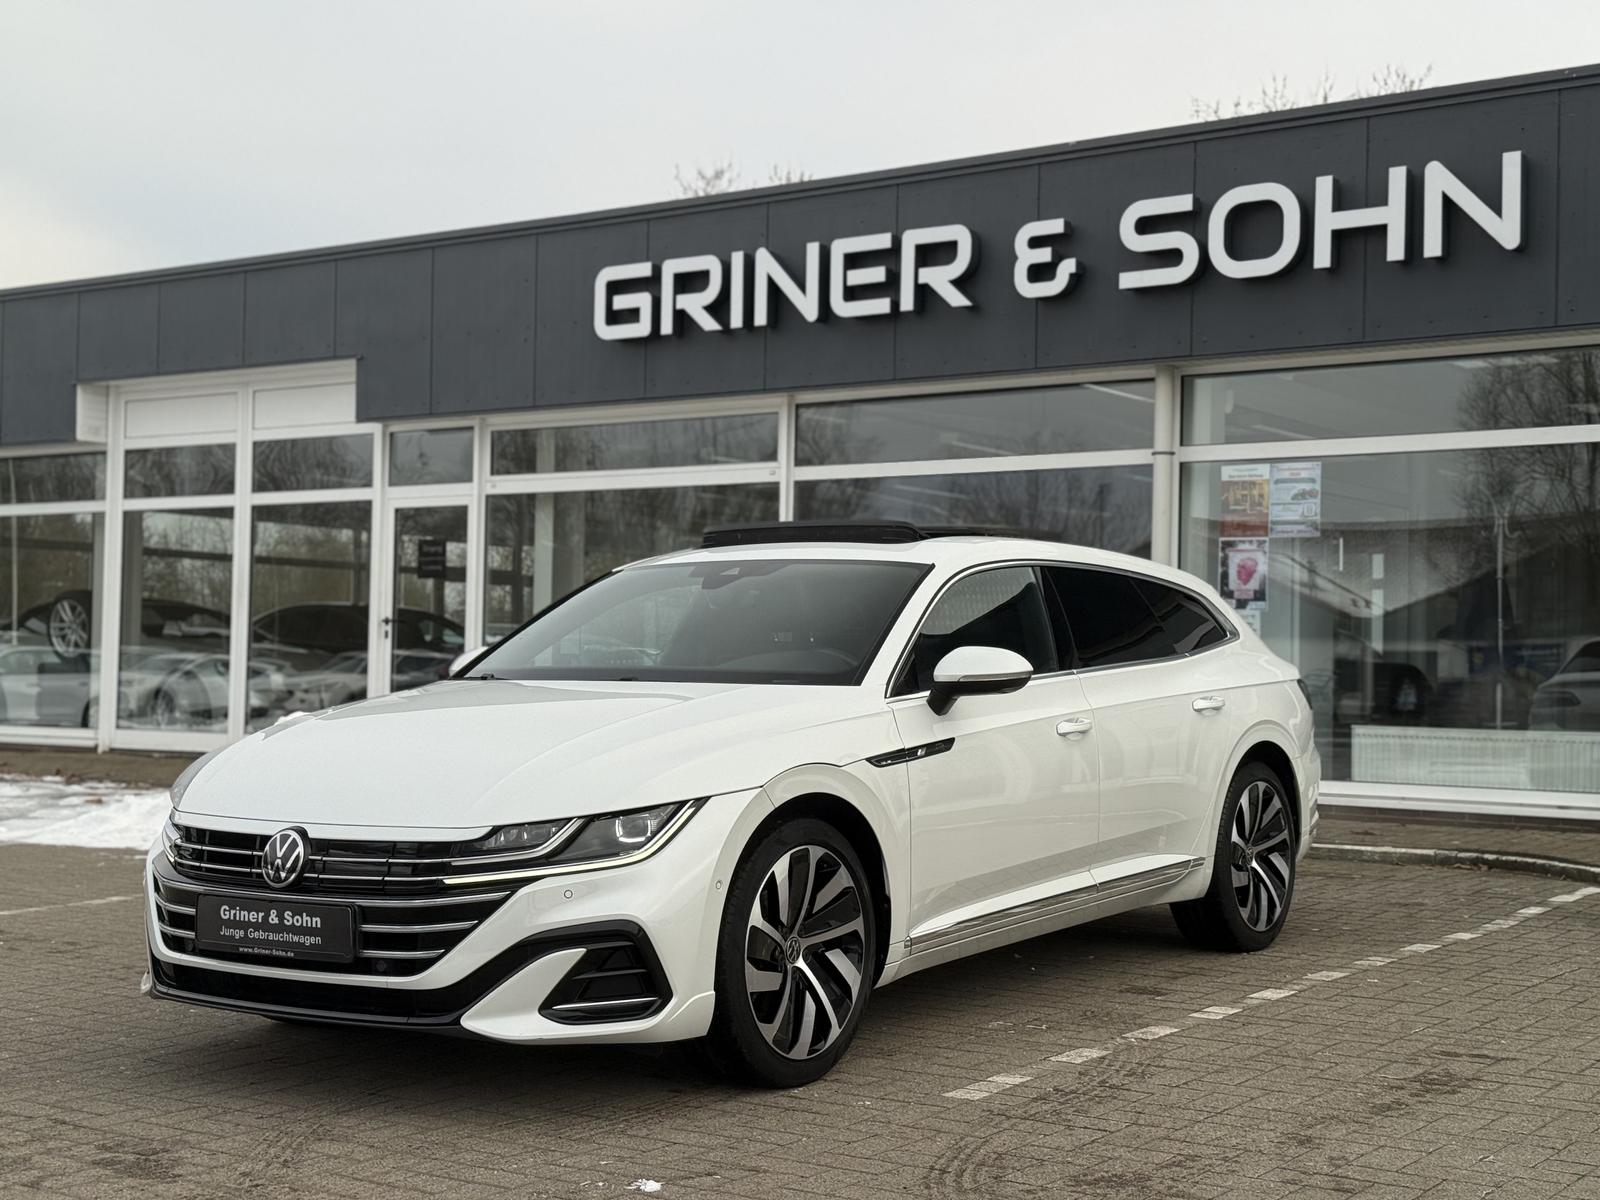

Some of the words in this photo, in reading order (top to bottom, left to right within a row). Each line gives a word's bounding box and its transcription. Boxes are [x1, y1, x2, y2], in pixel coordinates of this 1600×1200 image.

[594, 224, 974, 340] GRINER
[1013, 217, 1077, 299] &
[1118, 150, 1522, 290] SOHN
[219, 904, 265, 923] Griner
[268, 909, 279, 925] &
[283, 910, 322, 928] Sohn
[219, 925, 245, 939] Junge
[247, 928, 322, 946] Gebrauchtwagen
